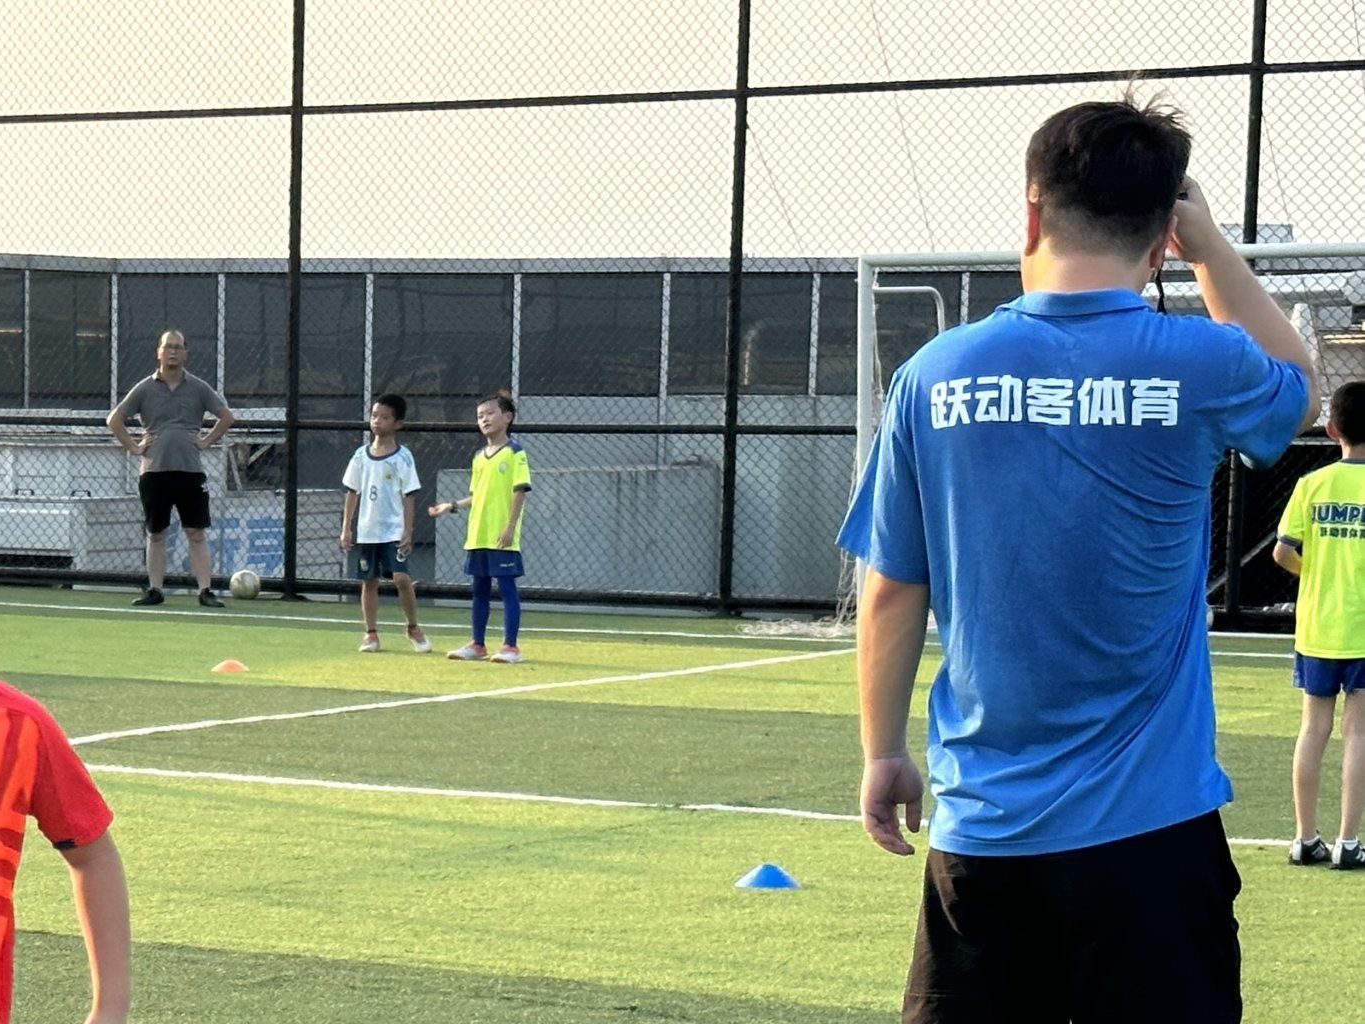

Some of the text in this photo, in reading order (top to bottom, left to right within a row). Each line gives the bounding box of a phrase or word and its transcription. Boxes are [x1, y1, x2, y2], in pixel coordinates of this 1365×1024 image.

[930, 374, 1181, 429] 跃动客体育
[369, 486, 378, 501] 8
[1311, 502, 1365, 525] JUMP
